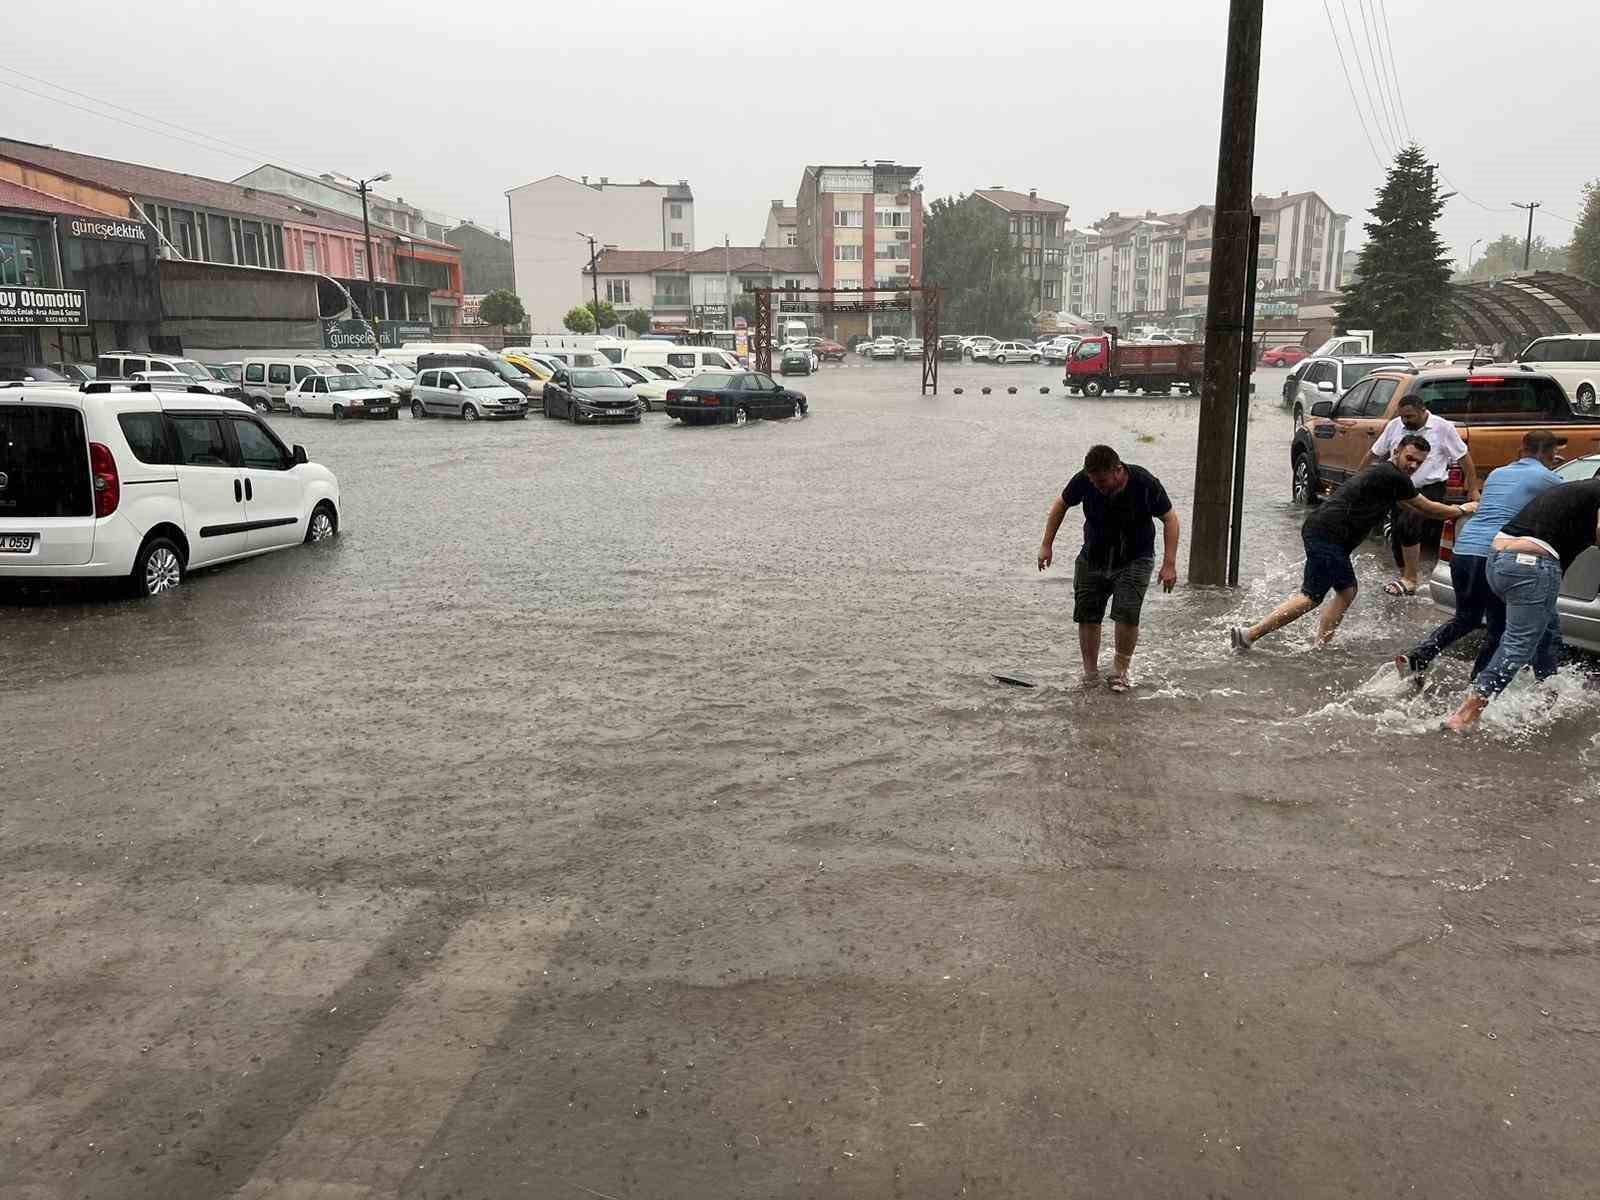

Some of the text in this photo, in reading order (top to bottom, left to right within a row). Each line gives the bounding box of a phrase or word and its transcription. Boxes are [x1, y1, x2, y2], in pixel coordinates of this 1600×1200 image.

[71, 218, 146, 240] güneşelektrik
[21, 291, 82, 307] Otomotiv
[9, 537, 30, 548] 059
